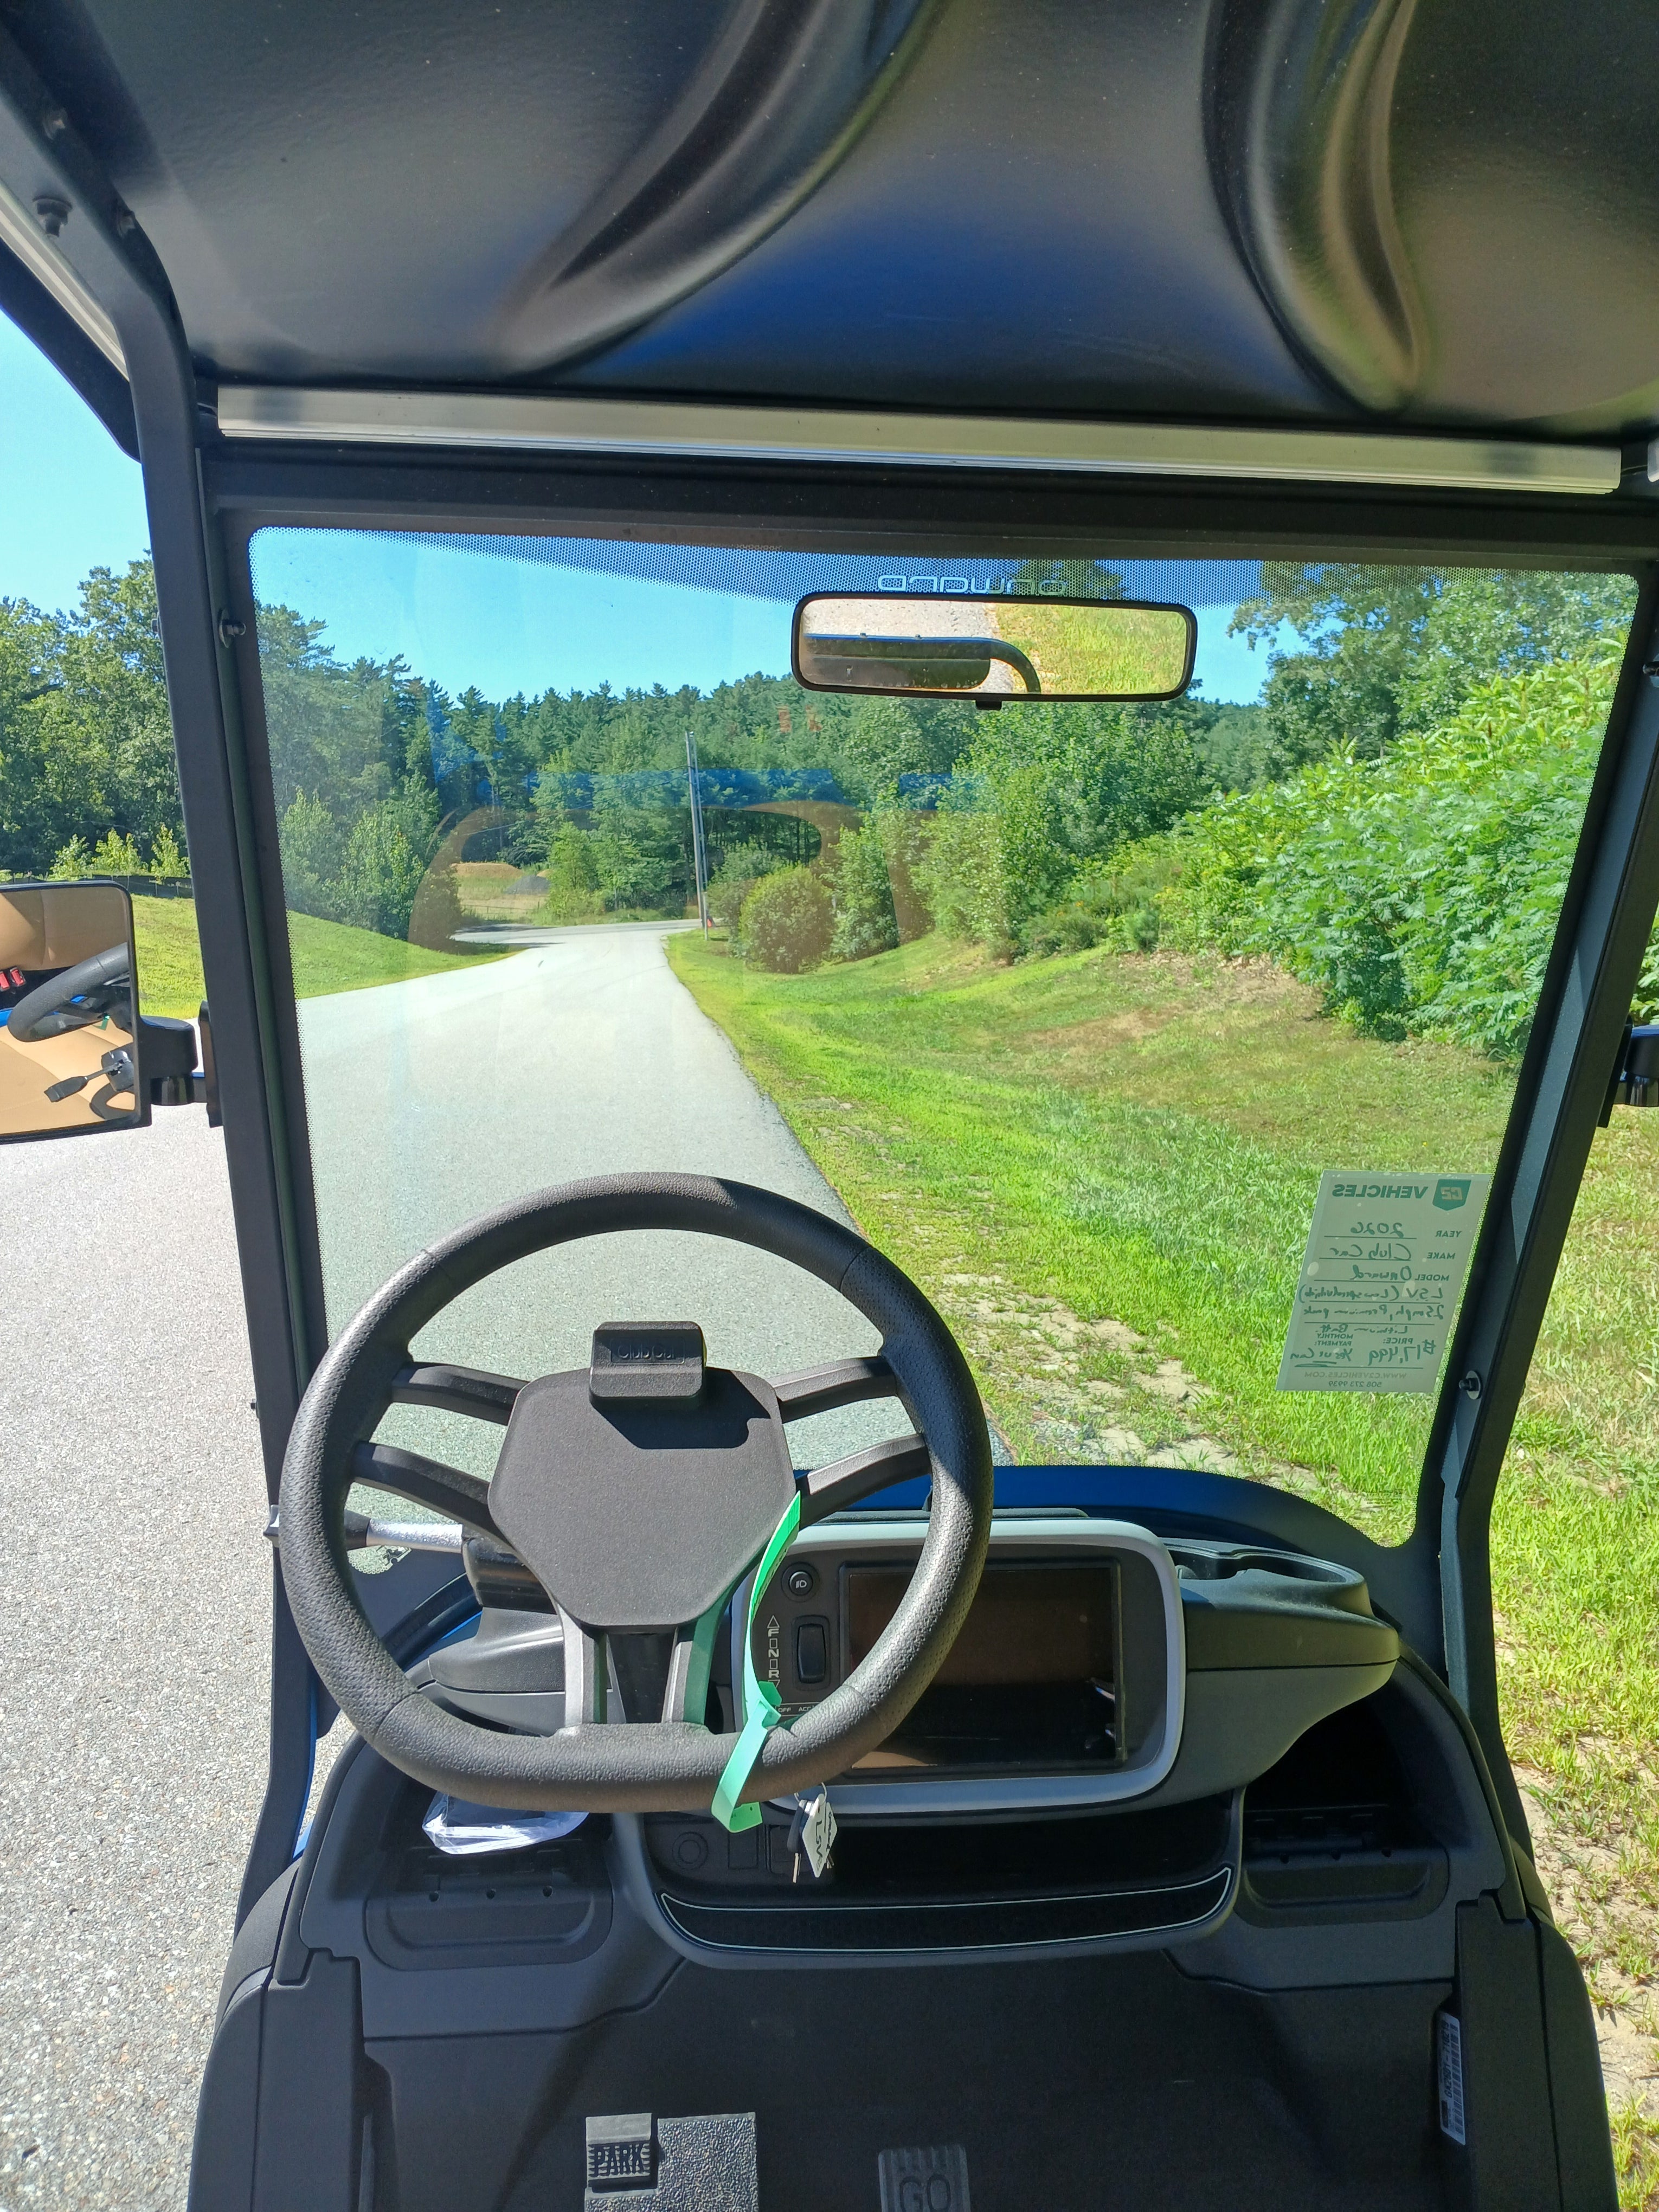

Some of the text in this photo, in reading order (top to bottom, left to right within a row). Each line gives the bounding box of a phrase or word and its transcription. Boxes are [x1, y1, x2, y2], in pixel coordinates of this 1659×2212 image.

[618, 1343, 675, 1359] Club Car
[768, 1628, 779, 1637] F
[768, 1649, 779, 1657] N
[768, 1669, 780, 1679] R
[594, 2145, 644, 2174] PARK
[898, 2174, 952, 2212] GO
